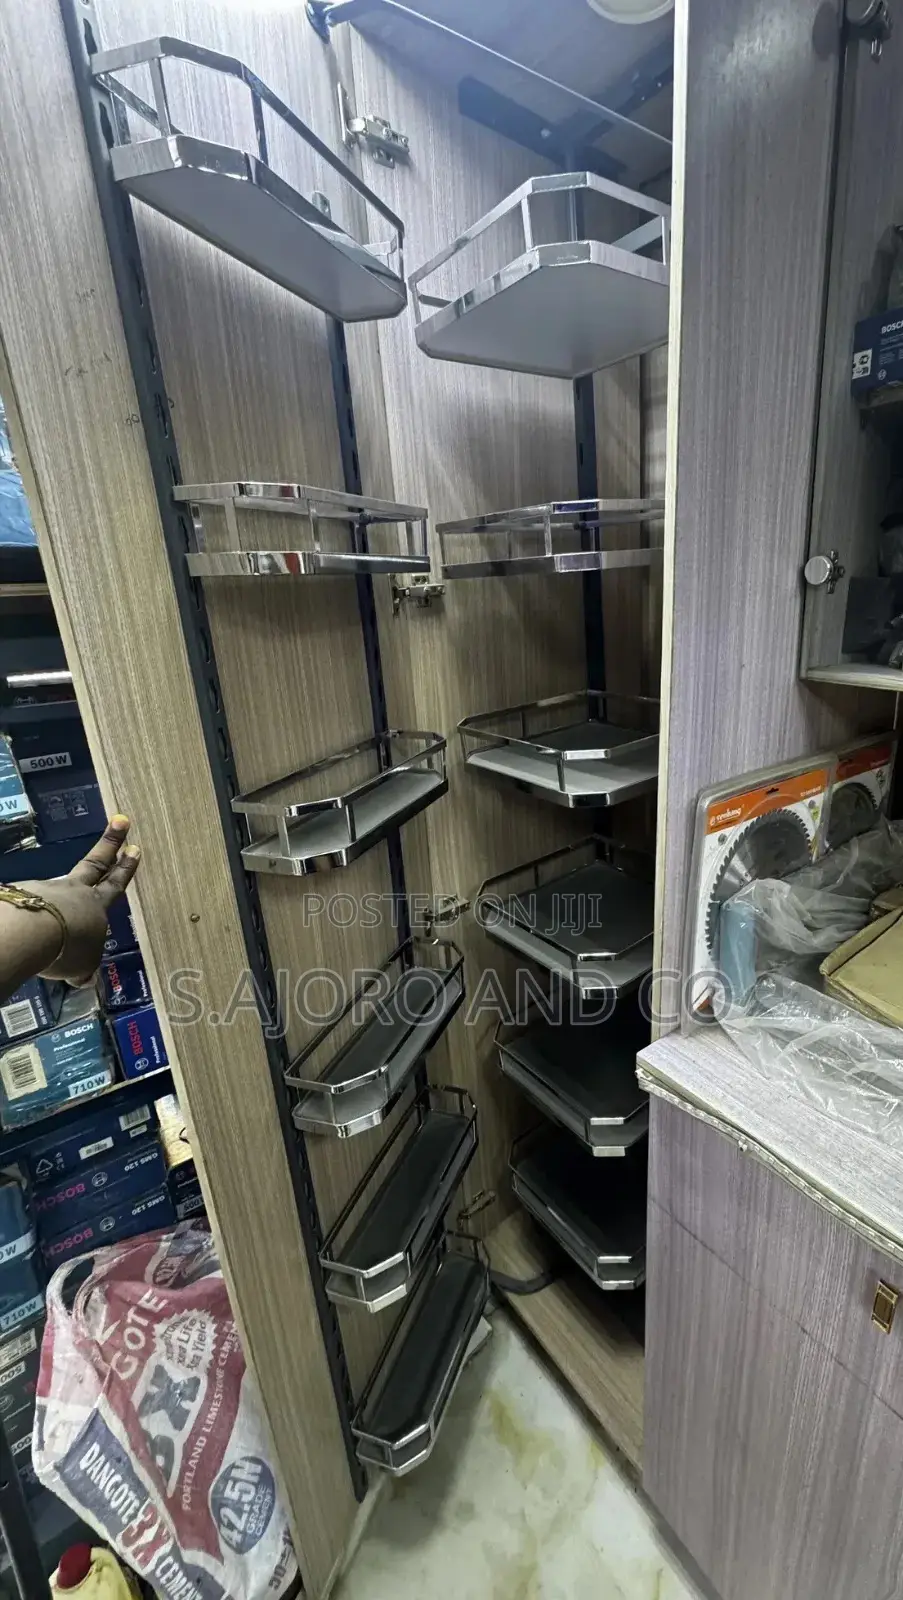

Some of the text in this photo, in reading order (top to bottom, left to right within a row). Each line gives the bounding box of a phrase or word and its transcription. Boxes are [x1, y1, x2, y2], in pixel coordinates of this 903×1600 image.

[30, 756, 54, 769] 500
[107, 962, 122, 992] BOSCH
[64, 1022, 94, 1038] BOSCH
[127, 1020, 144, 1056] BOSCH
[149, 1036, 161, 1064] Professional
[36, 1183, 86, 1212] BOSCH
[103, 1288, 168, 1380] GOTE
[182, 1437, 207, 1511] PORTLAND
[203, 1367, 226, 1433] LIMESTONE
[218, 1325, 239, 1367] CEMEN
[79, 1441, 141, 1525] DANGOTE
[154, 1555, 204, 1600] CEMEN
[247, 1484, 267, 1534] GRADE
[255, 1487, 273, 1536] CEMENT
